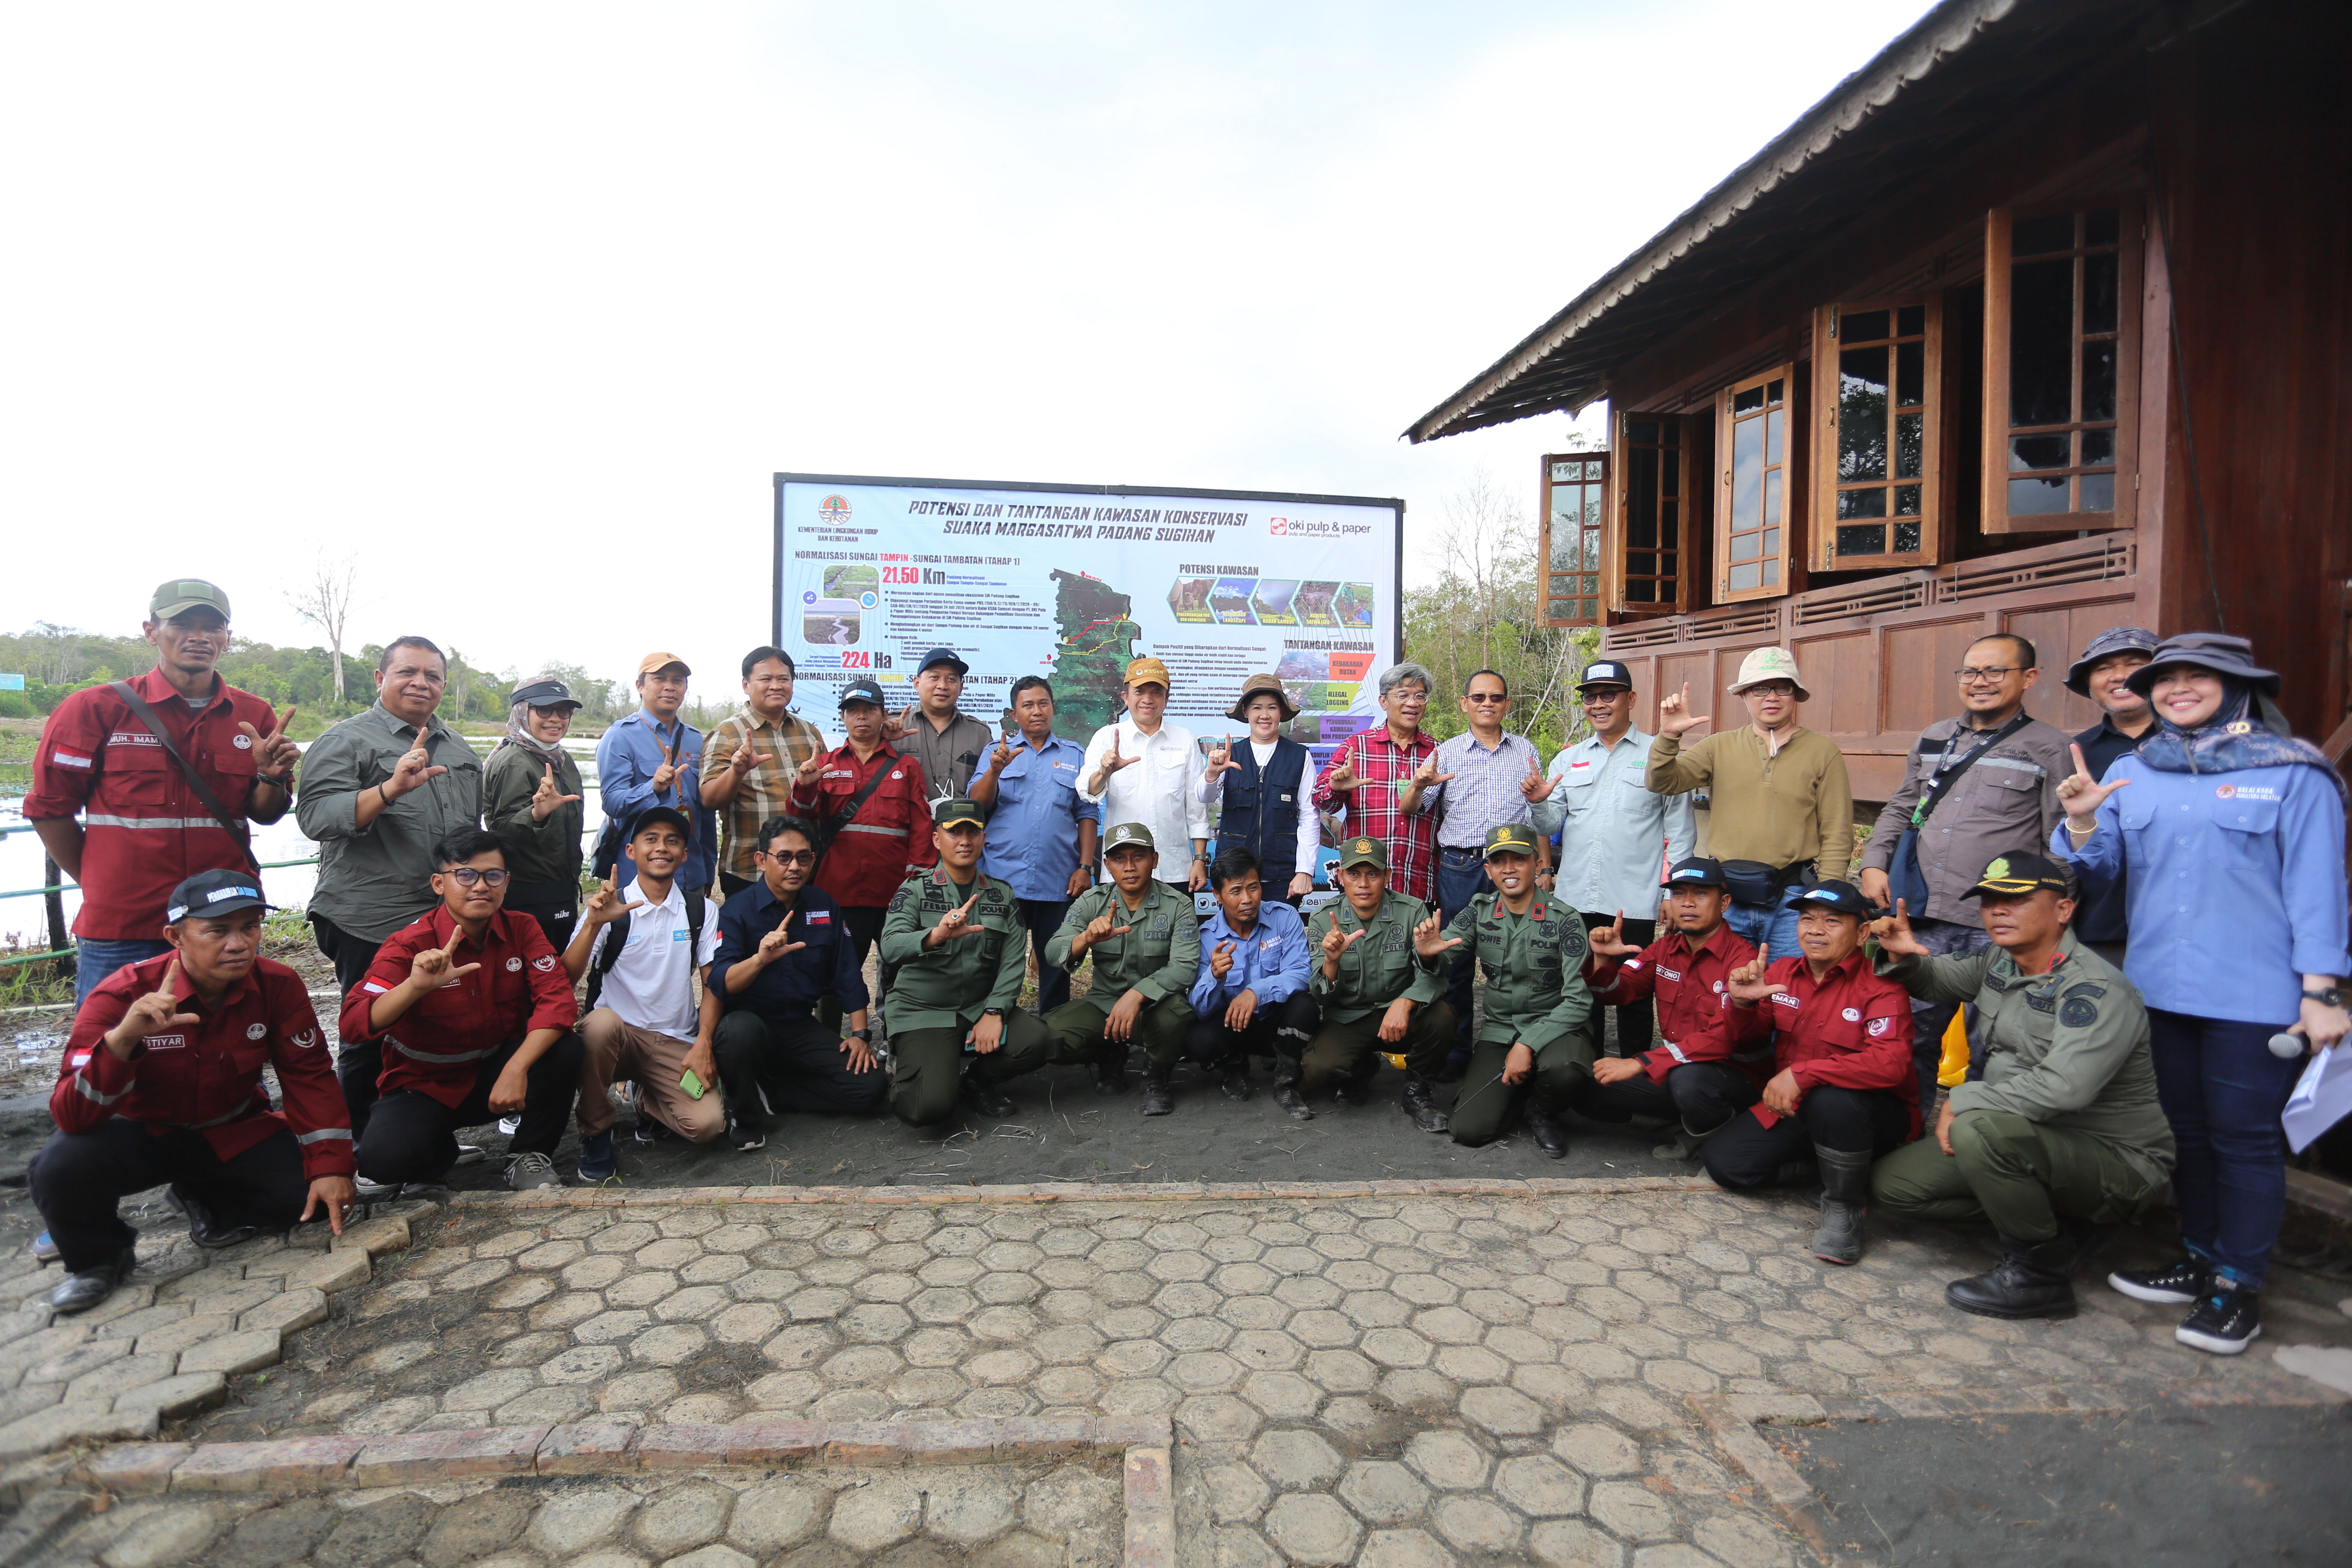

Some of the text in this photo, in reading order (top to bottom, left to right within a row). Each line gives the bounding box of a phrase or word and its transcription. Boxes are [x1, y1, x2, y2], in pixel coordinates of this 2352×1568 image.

[908, 501, 1248, 526] POTENSI DAN TANTANGAN KAWASAN KONSERVASI
[943, 521, 1216, 543] SUAKA MARGASATWA PADANG SUGIHAN
[1289, 521, 1371, 535] oki pulp & paper
[795, 551, 1020, 566] NORMALISASI SUNGAI TAMPIN -SUNGAI TAMBATAN (TAHAP 1)
[882, 566, 945, 585] 21,50 Km
[1179, 564, 1259, 576] POTENSI KAWASAN
[1284, 639, 1374, 651] TANTANGAN KAWASAN
[842, 651, 891, 668] 224 Ha
[794, 672, 846, 681] NORMALISASI
[848, 673, 876, 682] SUNGAI
[878, 674, 904, 682] CAKUR
[981, 676, 1008, 684] (TAHAP
[110, 735, 130, 744] MUH.
[925, 902, 951, 911] FEBRI
[554, 910, 570, 920] nike
[1656, 966, 1677, 979] DIYONO
[143, 1038, 181, 1047] STIYAR
